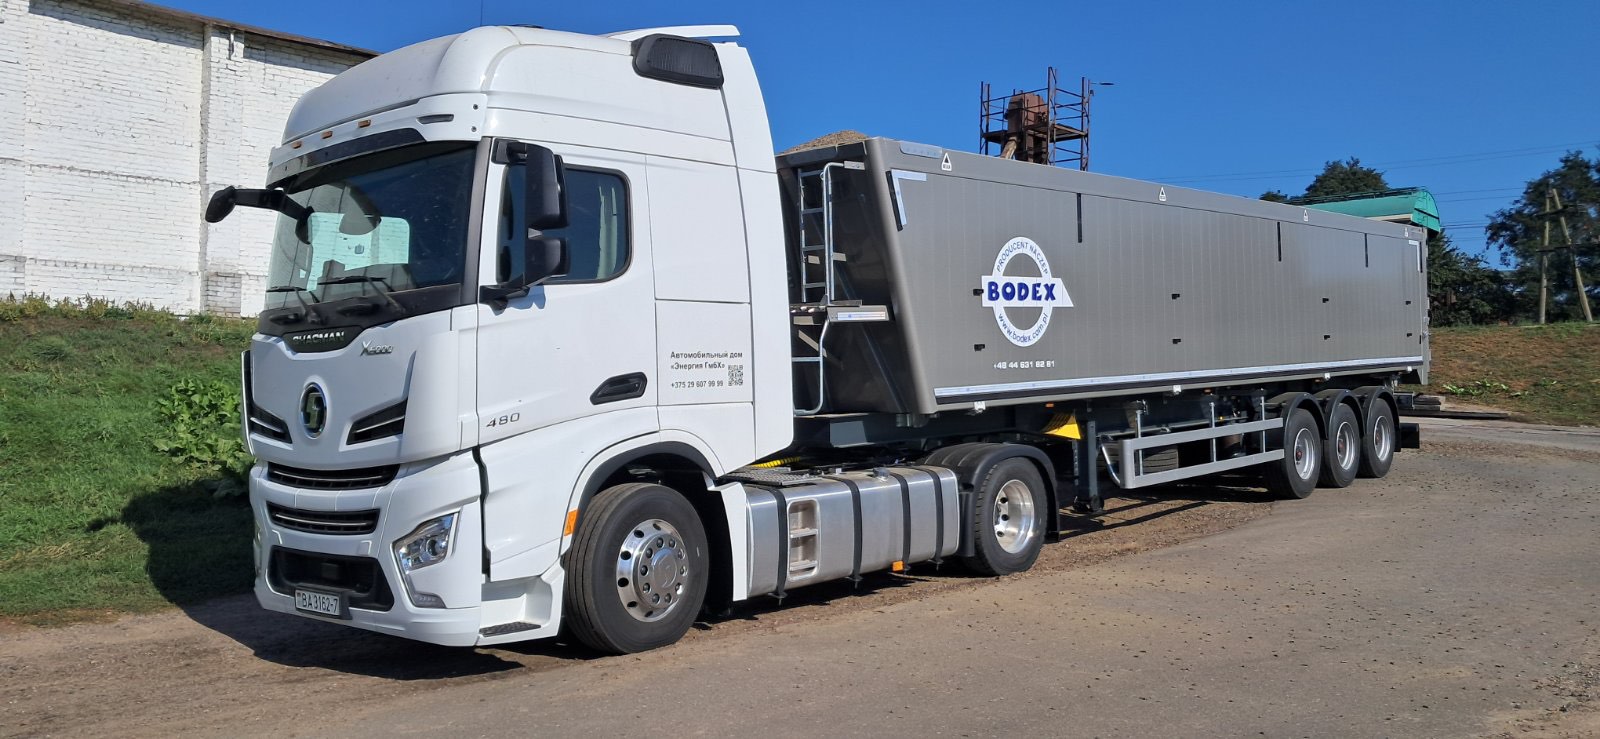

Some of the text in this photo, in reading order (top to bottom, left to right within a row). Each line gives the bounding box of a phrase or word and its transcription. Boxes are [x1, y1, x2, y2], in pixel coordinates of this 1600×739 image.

[997, 241, 1048, 274] PRODUCENT NACZEP
[987, 281, 1056, 301] BODEX
[998, 312, 1049, 343] www.bodex.com.pl
[670, 350, 729, 359] Автомобильный
[670, 361, 725, 370] «Энергия ГмбХ»
[993, 361, 1007, 369] +48
[1020, 361, 1033, 369] 631
[486, 412, 520, 427] 480
